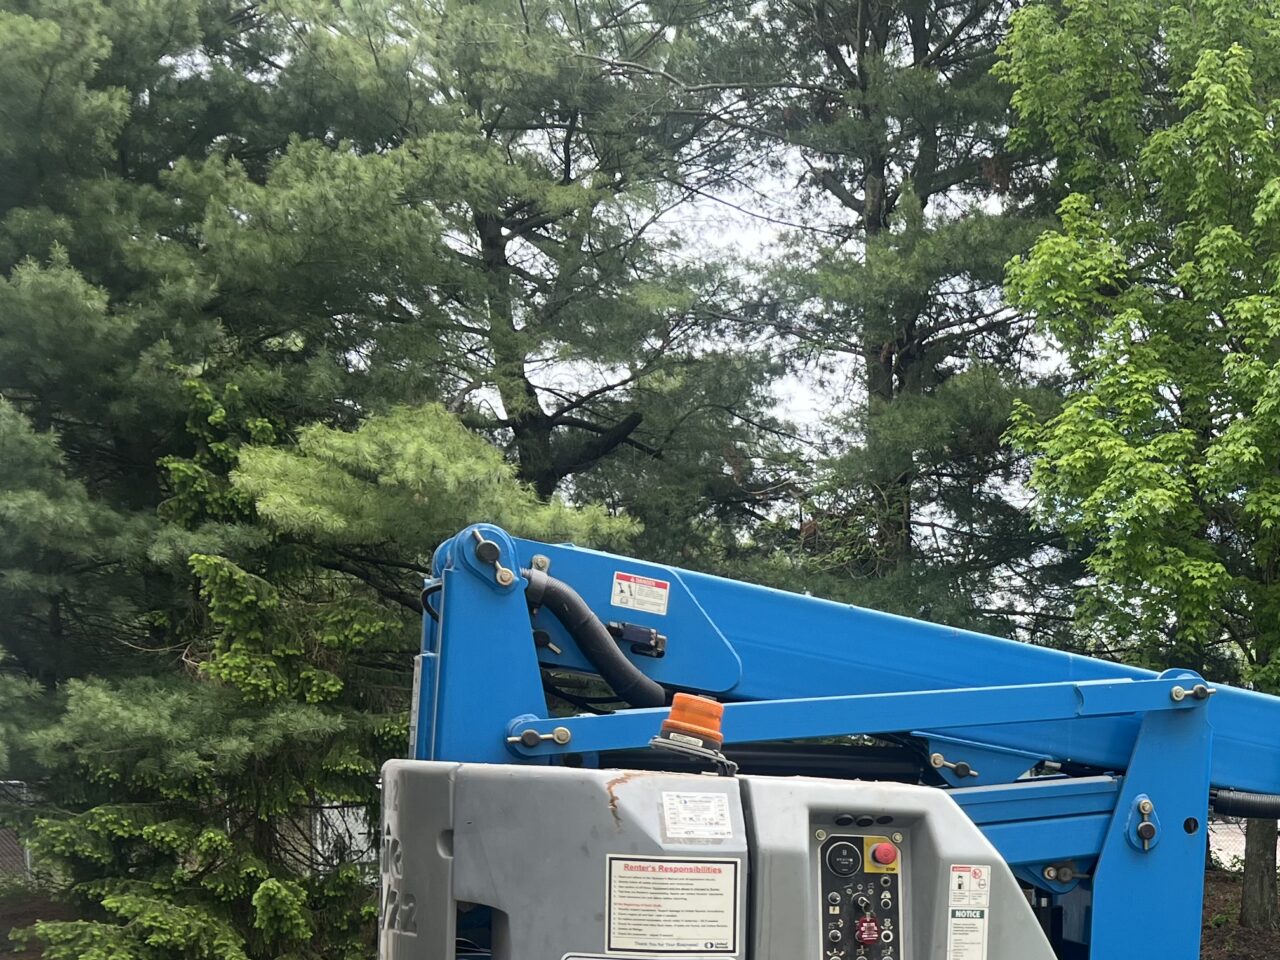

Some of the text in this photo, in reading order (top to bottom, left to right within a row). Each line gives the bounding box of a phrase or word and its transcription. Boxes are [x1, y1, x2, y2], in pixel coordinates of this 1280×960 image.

[623, 863, 723, 874] Renter's Responsibilities
[955, 910, 981, 918] NOTICE
